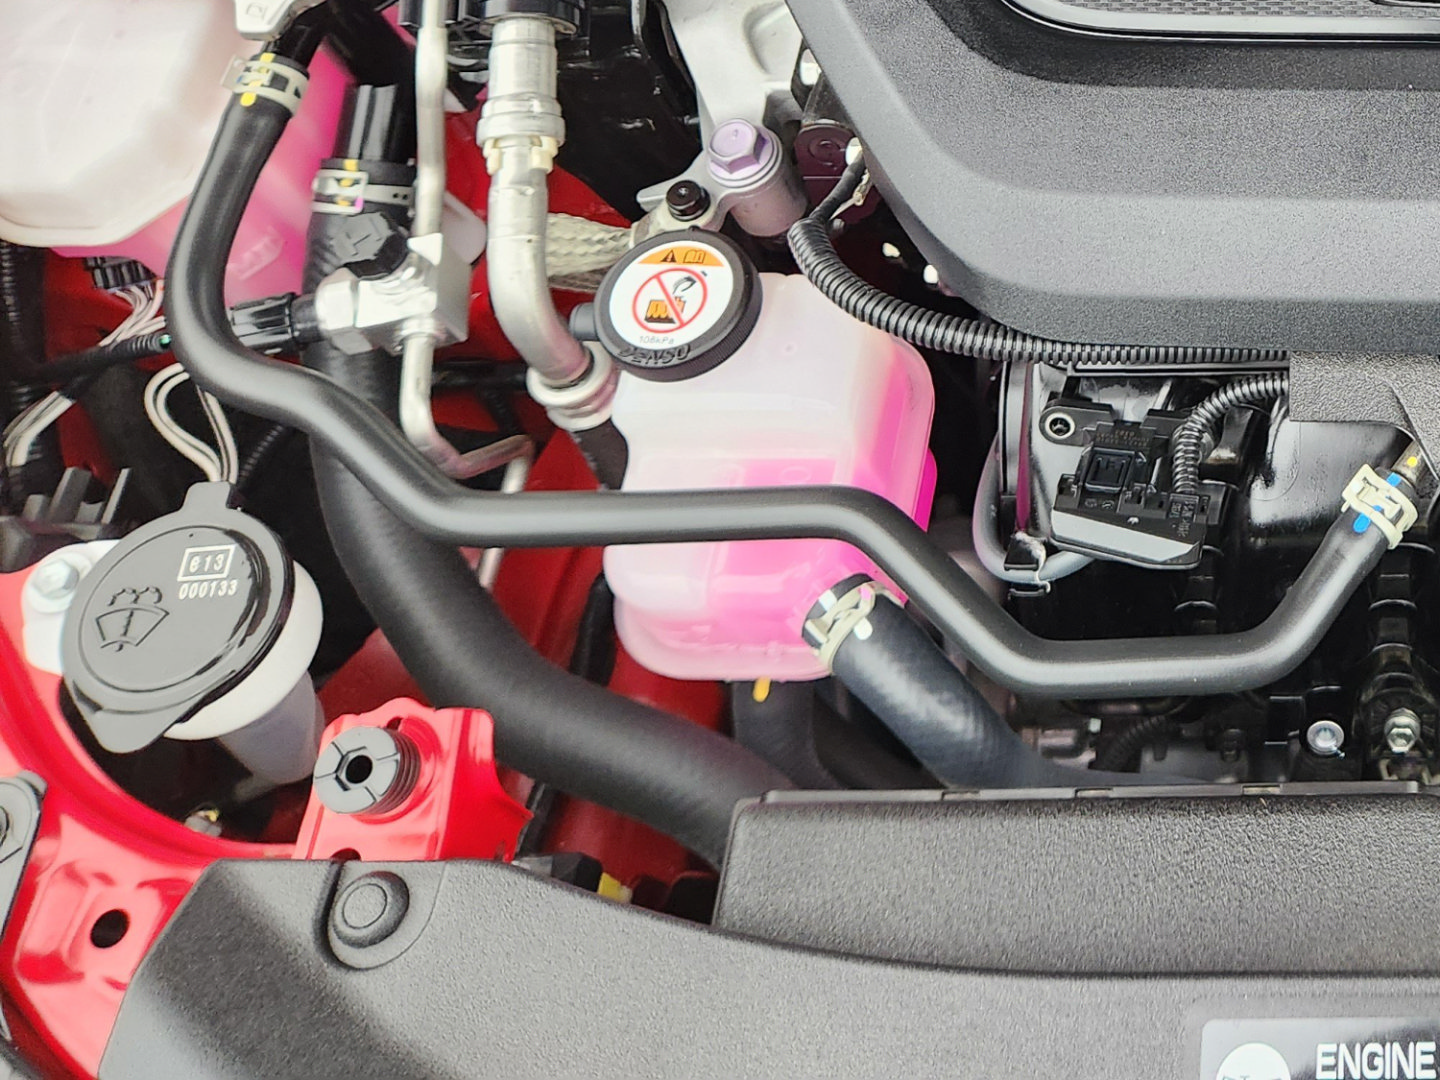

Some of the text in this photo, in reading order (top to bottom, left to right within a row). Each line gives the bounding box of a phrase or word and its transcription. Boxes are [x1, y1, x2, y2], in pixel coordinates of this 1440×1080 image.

[188, 552, 225, 573] e13
[178, 579, 239, 600] 000133
[1316, 1041, 1437, 1080] ENGINE
